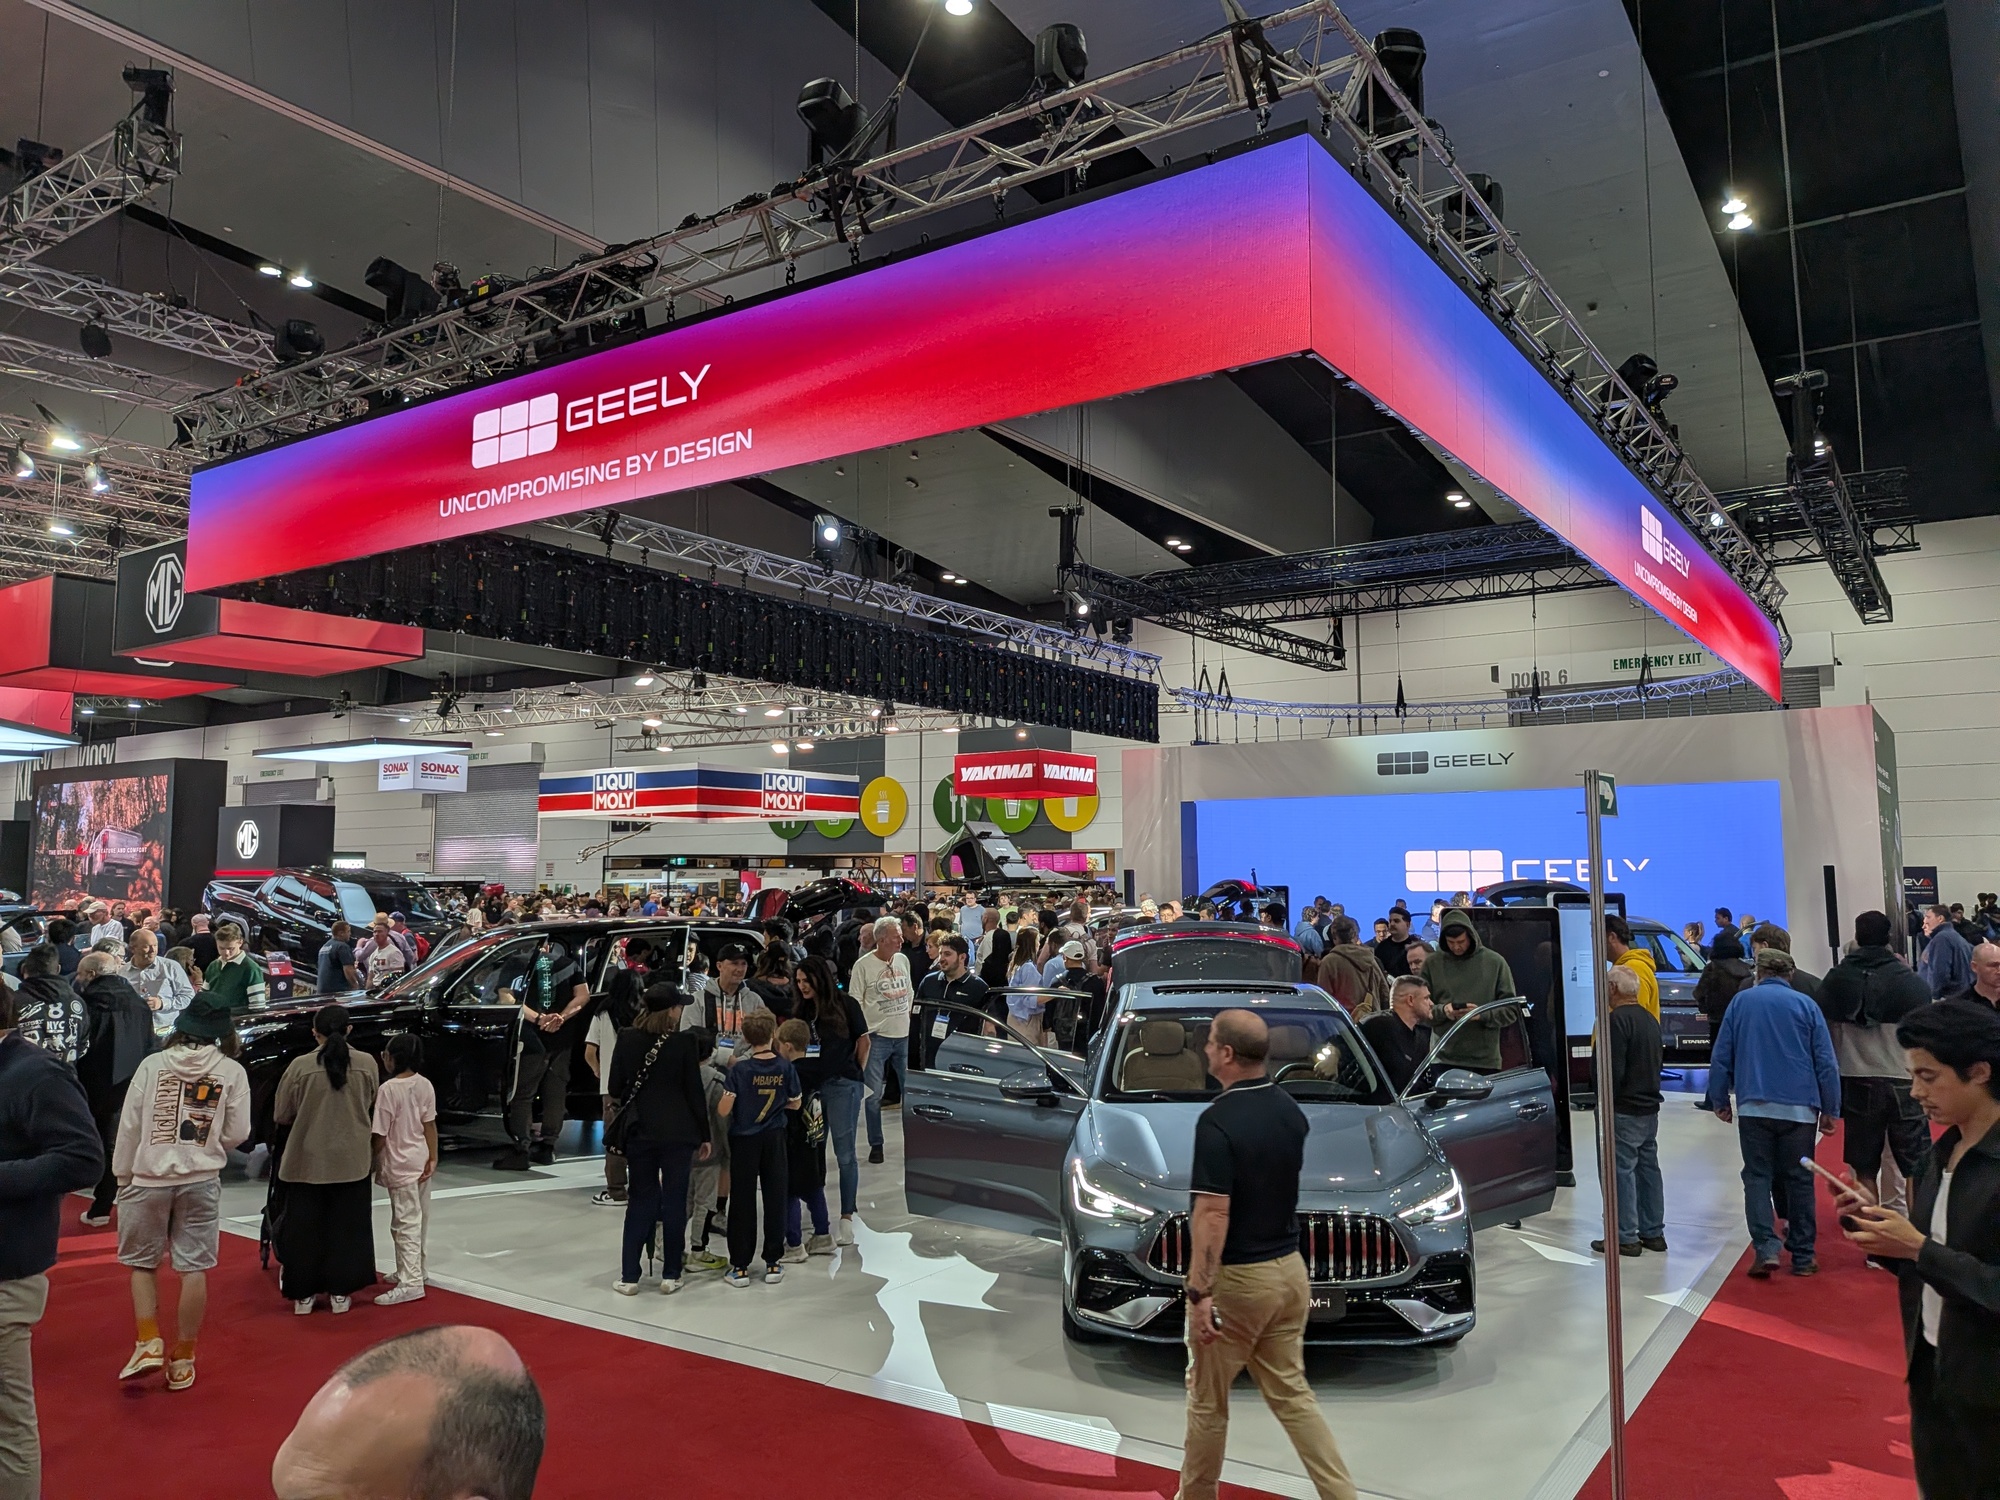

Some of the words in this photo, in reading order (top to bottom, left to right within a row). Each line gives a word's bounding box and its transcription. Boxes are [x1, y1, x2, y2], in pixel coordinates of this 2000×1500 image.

[566, 364, 711, 432] GEELY
[439, 459, 621, 518] UNCOMPROMISING
[626, 450, 659, 477] BY
[663, 428, 753, 468] DESIGN
[1663, 536, 1690, 580] GEELY
[147, 556, 182, 630] MG
[1613, 654, 1674, 670] EMERENCY
[1678, 652, 1702, 665] EXIT
[1558, 669, 1568, 685] 6
[383, 762, 409, 773] SONAX
[421, 762, 460, 774] SONAX
[1434, 752, 1515, 768] GEELY
[960, 763, 1033, 782] YAKIMA
[1043, 763, 1094, 783] YAKIMA
[595, 773, 633, 792] LIQUI
[765, 773, 803, 793] LIQUI
[595, 792, 634, 811] MOLY
[764, 793, 804, 811] MOLY
[238, 821, 258, 857] MG
[46, 1021, 65, 1030] NYC
[752, 1073, 784, 1086] MBAPPÉ
[756, 1088, 777, 1123] 7
